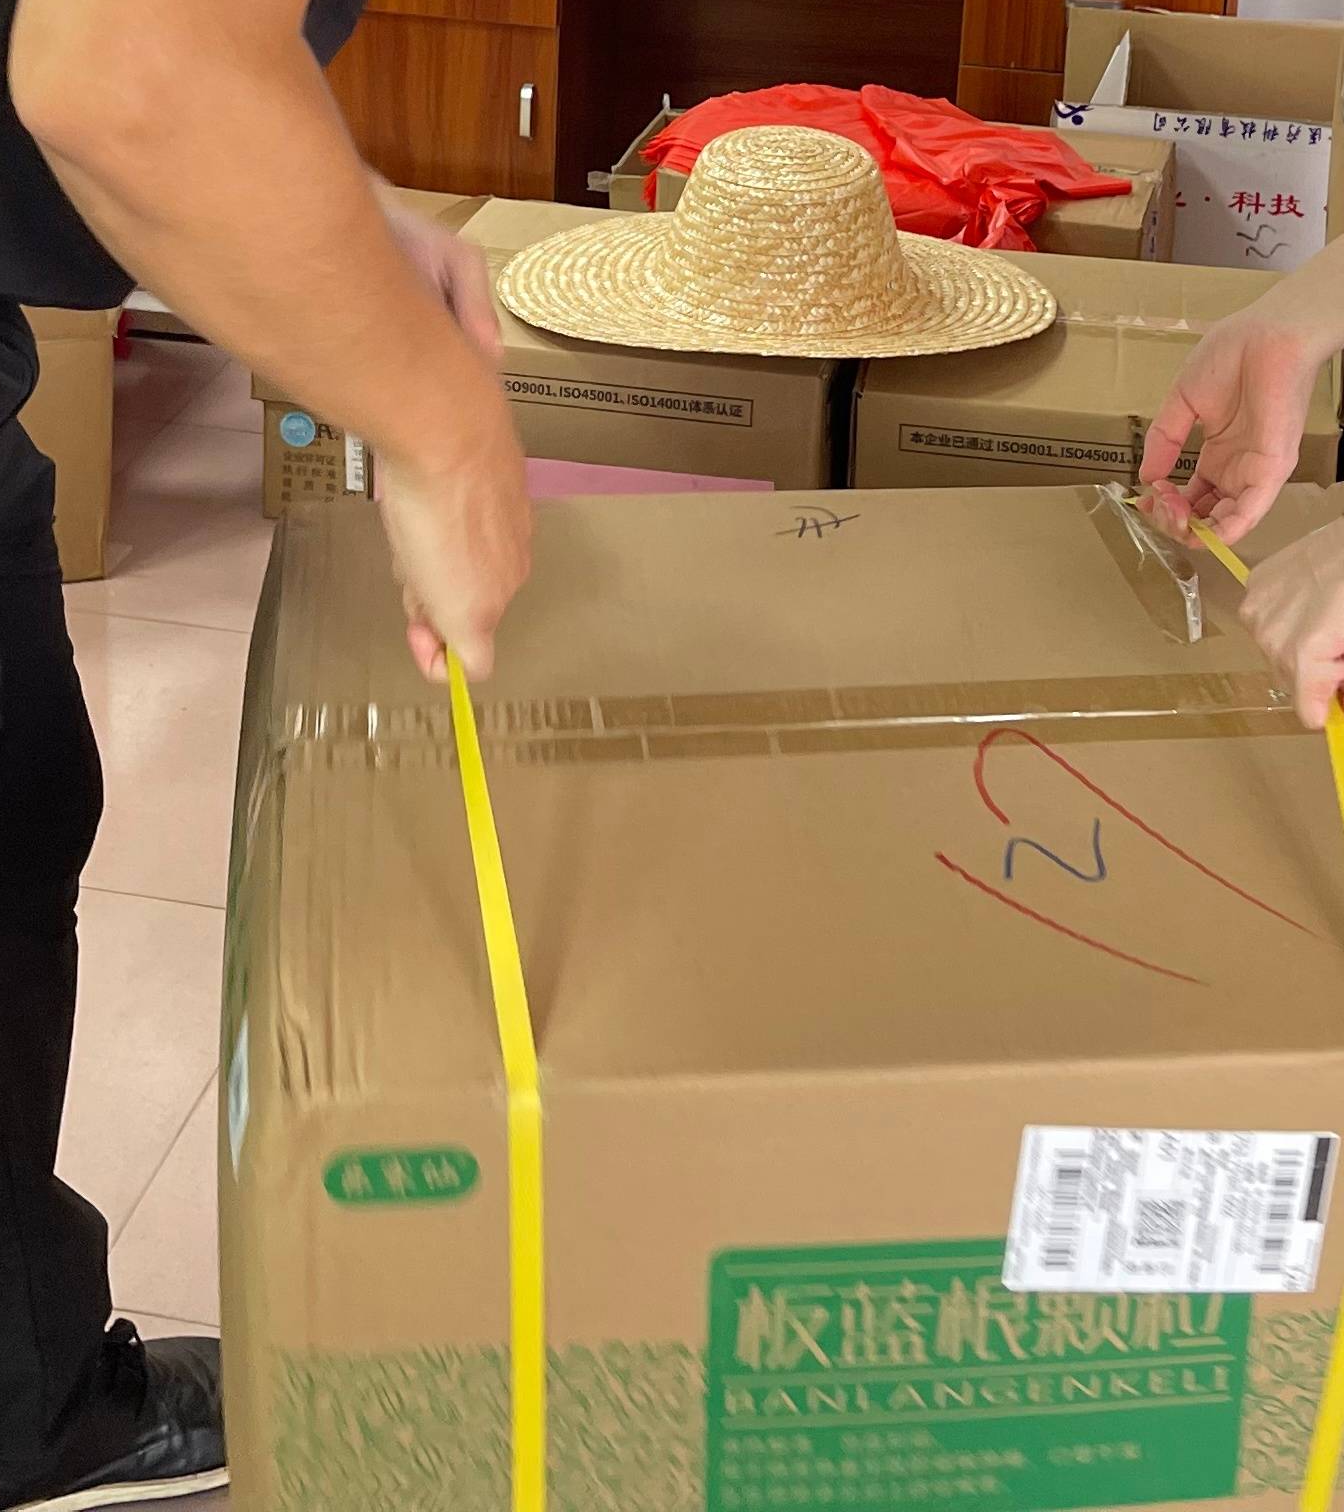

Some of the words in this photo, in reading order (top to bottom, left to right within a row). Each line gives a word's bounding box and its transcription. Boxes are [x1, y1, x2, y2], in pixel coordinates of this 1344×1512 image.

[1153, 113, 1322, 145] 医疗科技有限公司
[1228, 192, 1304, 218] 科技
[504, 380, 743, 418] SO9001、ISO45001、ISO14001体系认证
[910, 431, 993, 452] 本企业已通过
